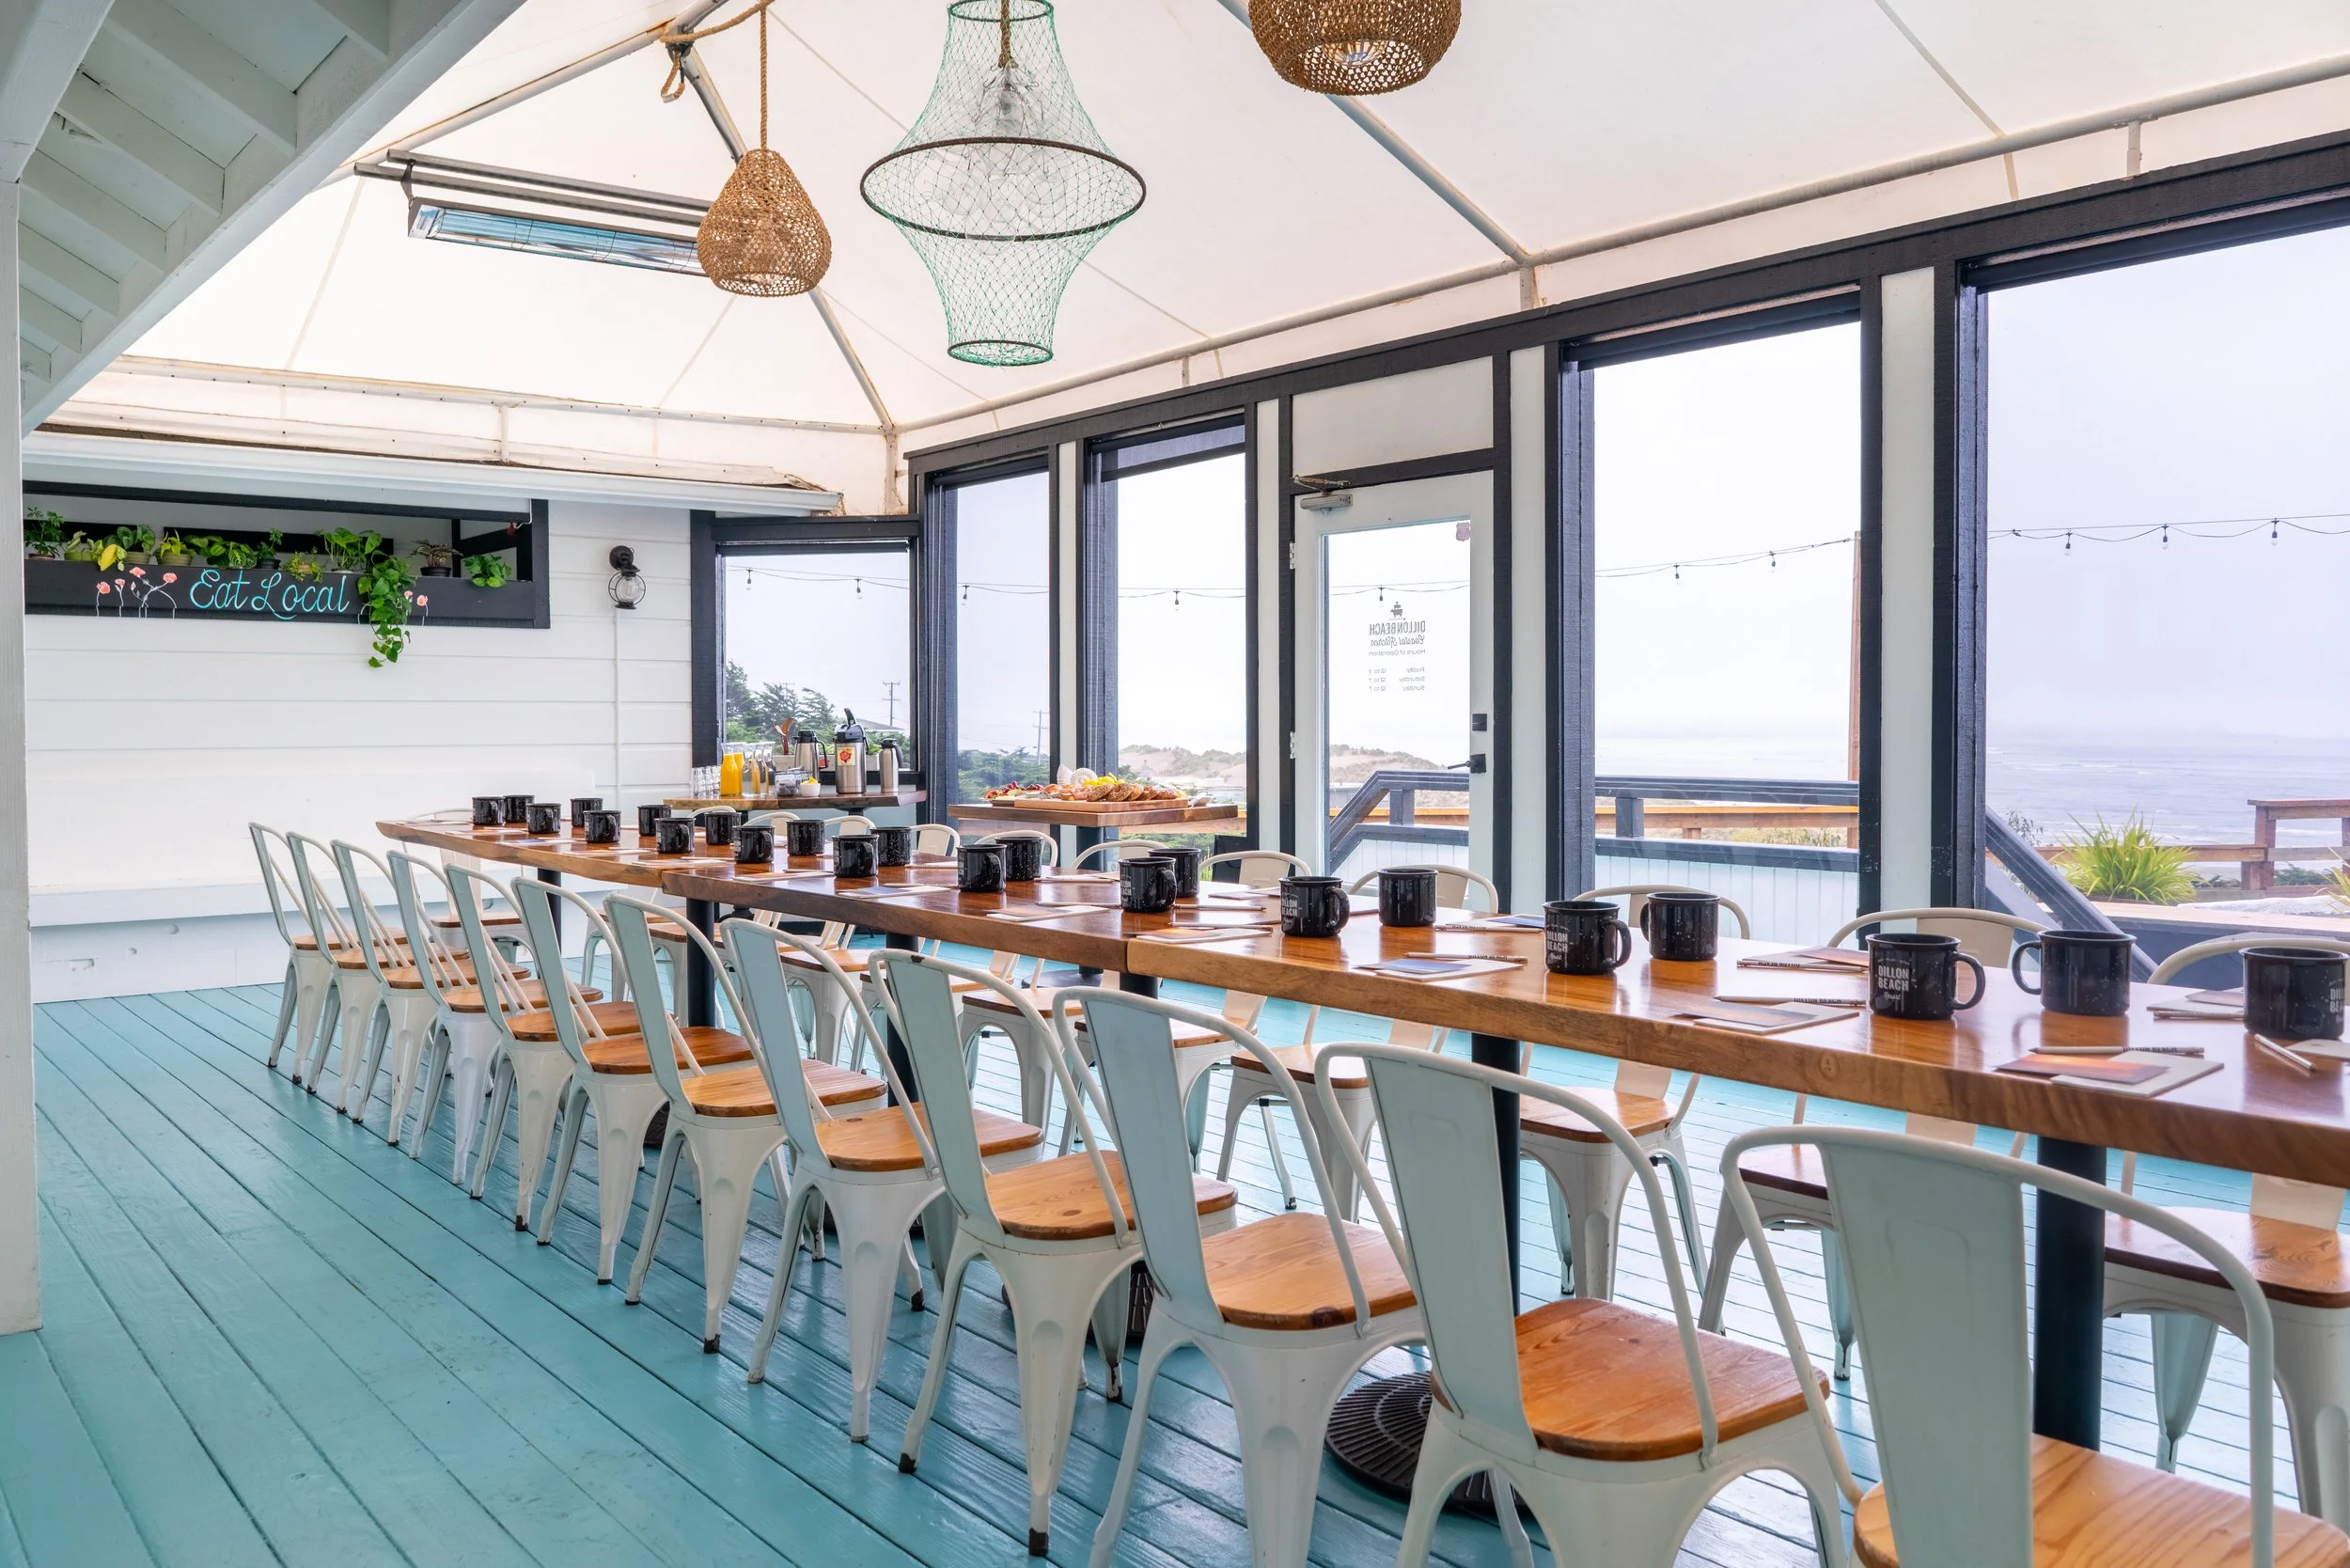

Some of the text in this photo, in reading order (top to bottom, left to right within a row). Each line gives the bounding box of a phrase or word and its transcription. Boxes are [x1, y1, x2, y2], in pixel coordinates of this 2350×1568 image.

[189, 568, 350, 619] Eat Local
[1878, 965, 1909, 980] DILLON
[1878, 978, 1909, 992] BEACH
